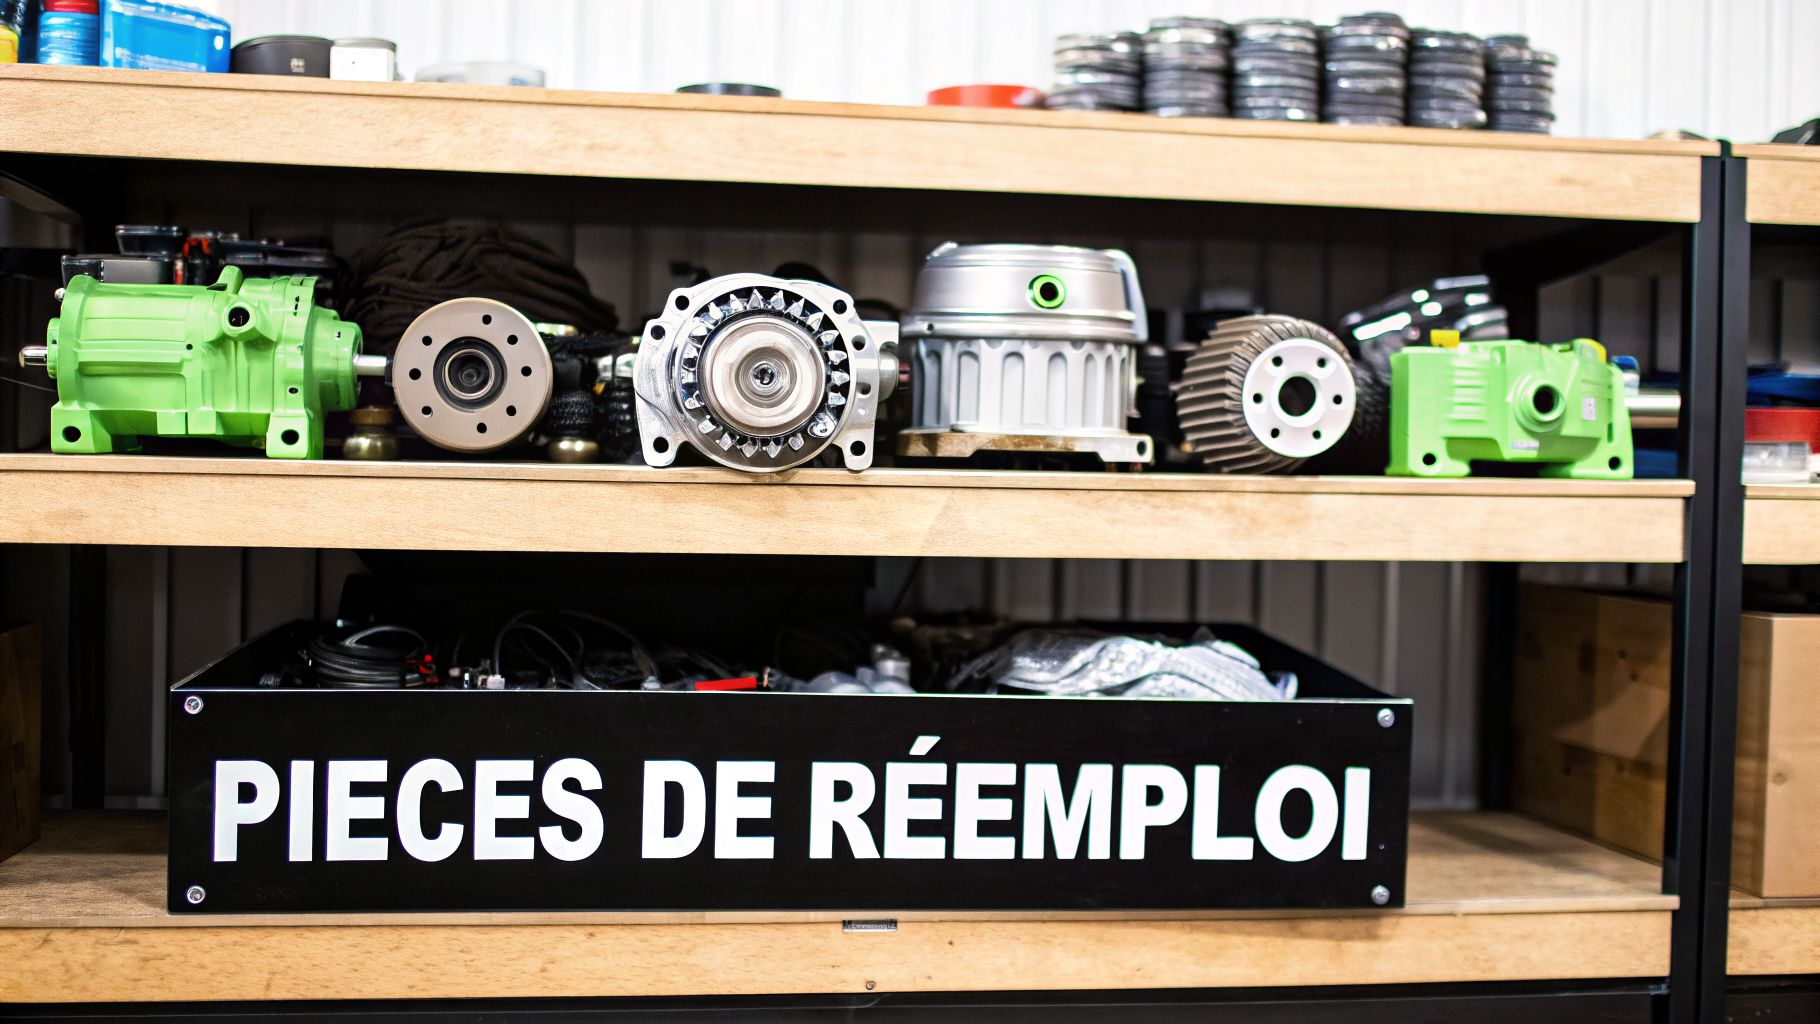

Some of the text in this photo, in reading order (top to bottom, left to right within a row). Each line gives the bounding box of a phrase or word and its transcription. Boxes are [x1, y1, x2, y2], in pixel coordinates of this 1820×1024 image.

[213, 735, 1371, 862] PIECES DE RÉEMPLOI
